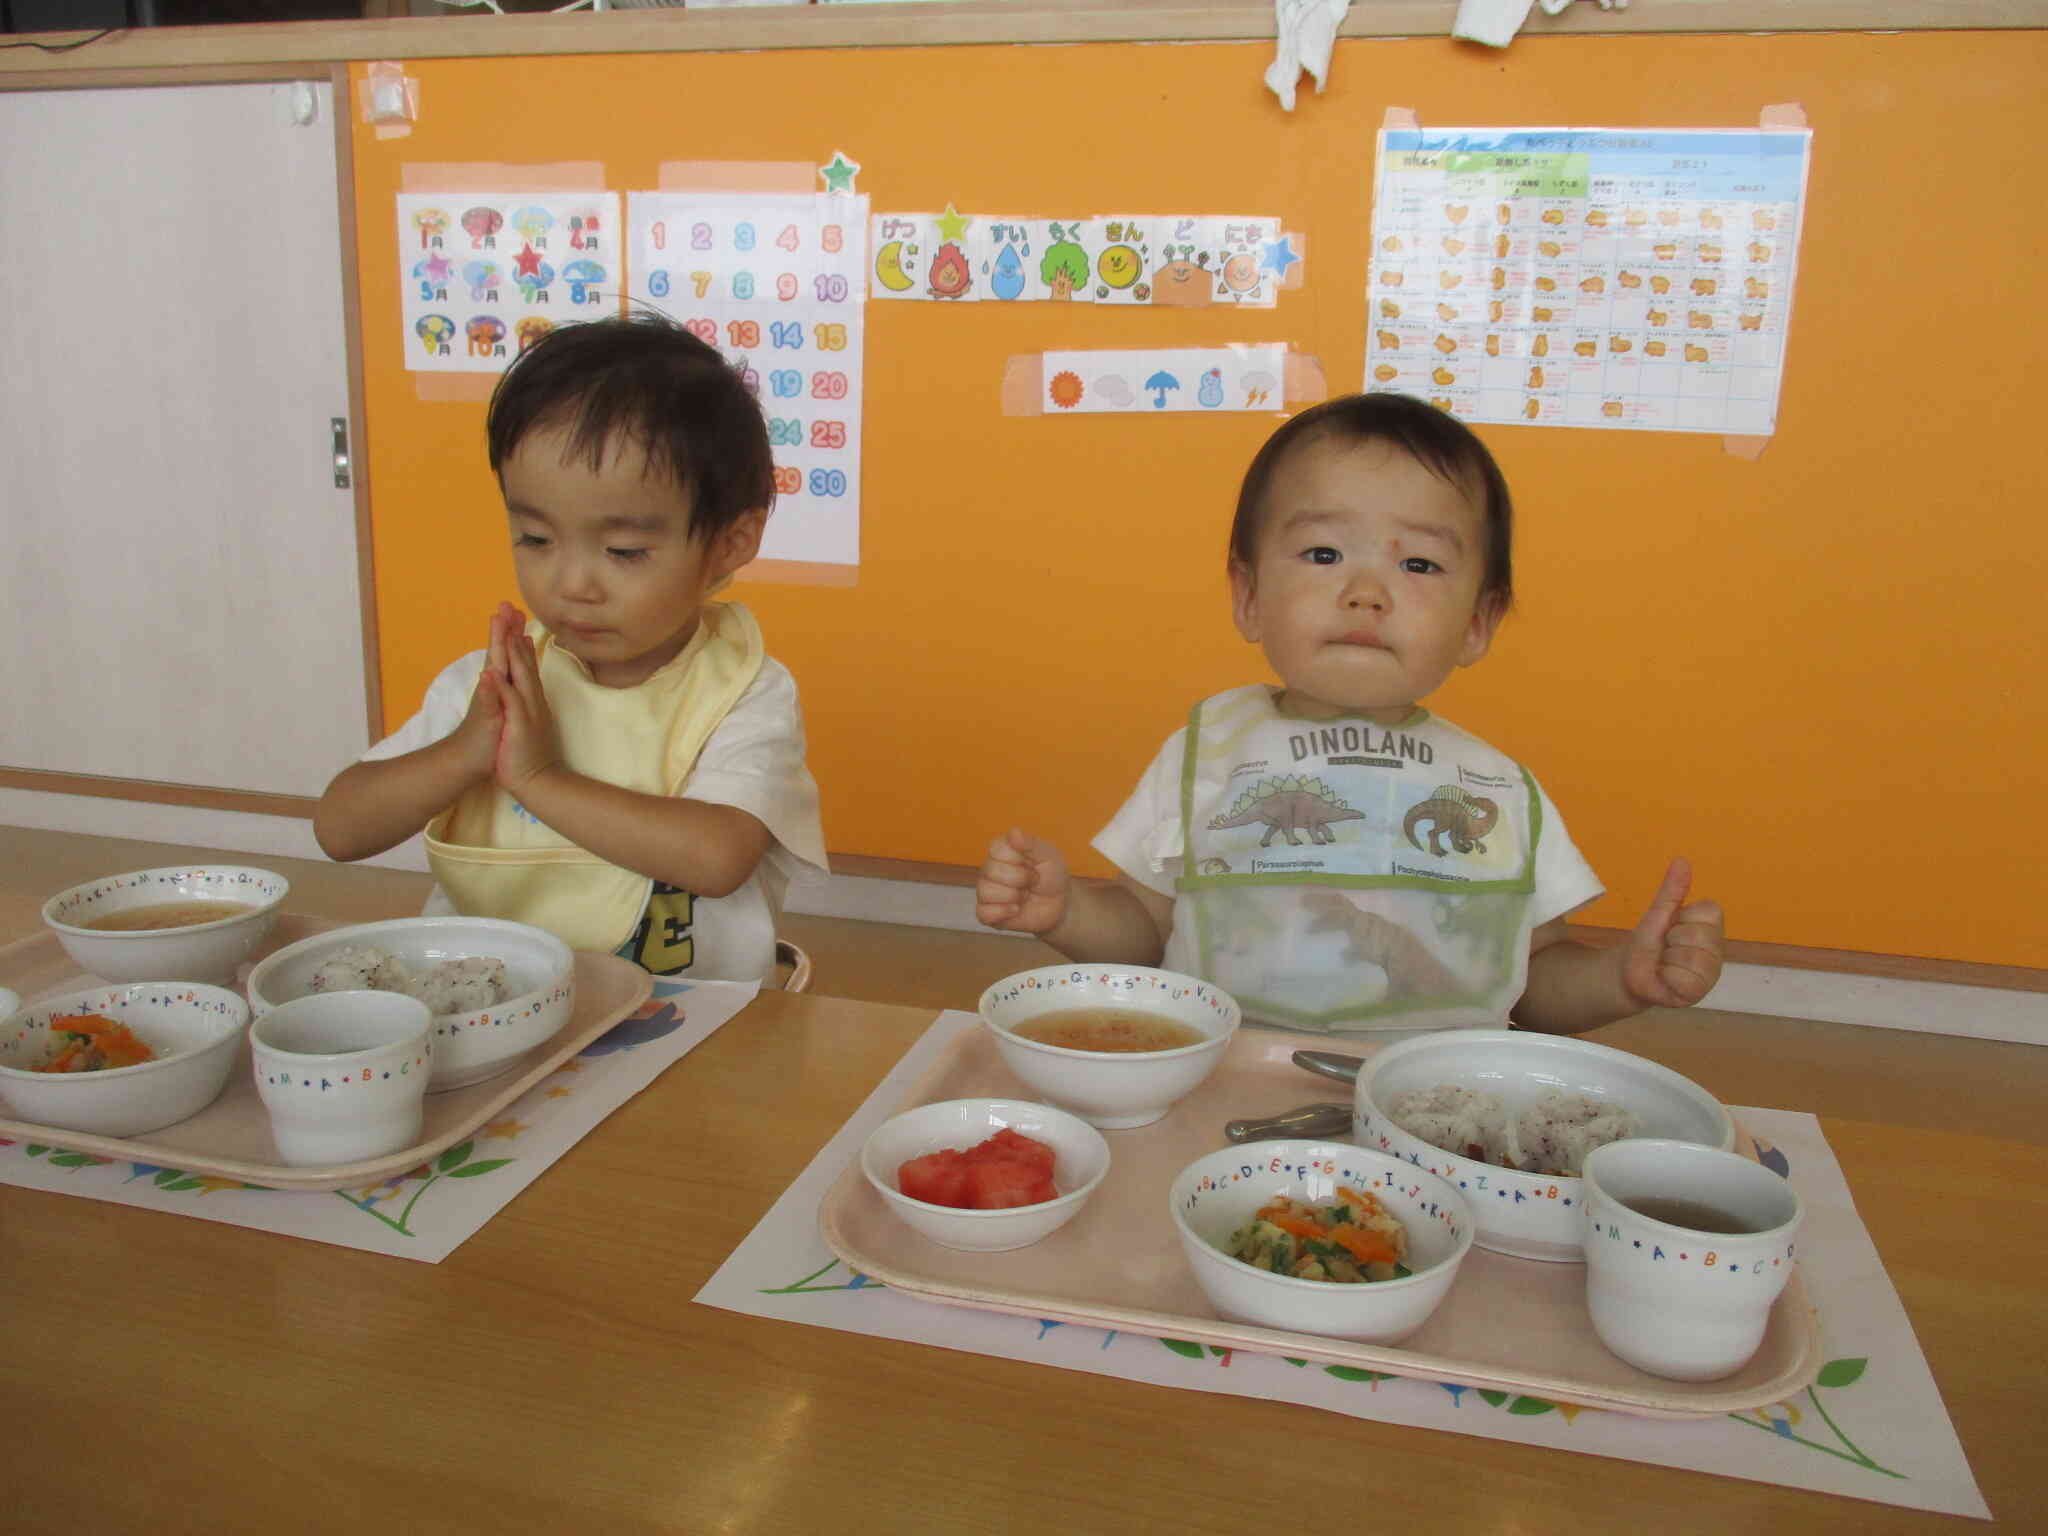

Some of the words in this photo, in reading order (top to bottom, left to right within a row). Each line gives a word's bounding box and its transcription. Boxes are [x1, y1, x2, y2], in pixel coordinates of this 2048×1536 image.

[652, 221, 666, 250] 1
[691, 222, 713, 251] 2
[733, 222, 756, 251] 3
[776, 224, 800, 252] 4
[821, 224, 843, 253] 5
[882, 218, 916, 239] げつ
[990, 223, 1028, 242] すい
[649, 269, 669, 297] 6
[690, 271, 712, 298] 7
[776, 273, 798, 301] 9
[814, 274, 848, 303] 10
[727, 319, 760, 349] 13
[769, 321, 804, 350] 14
[814, 322, 847, 351] 15
[769, 369, 802, 398] 19
[811, 371, 847, 400] 20
[768, 416, 803, 447] 24
[810, 419, 846, 450] 25
[809, 468, 847, 497] 30
[1288, 726, 1434, 765] DINOLAND
